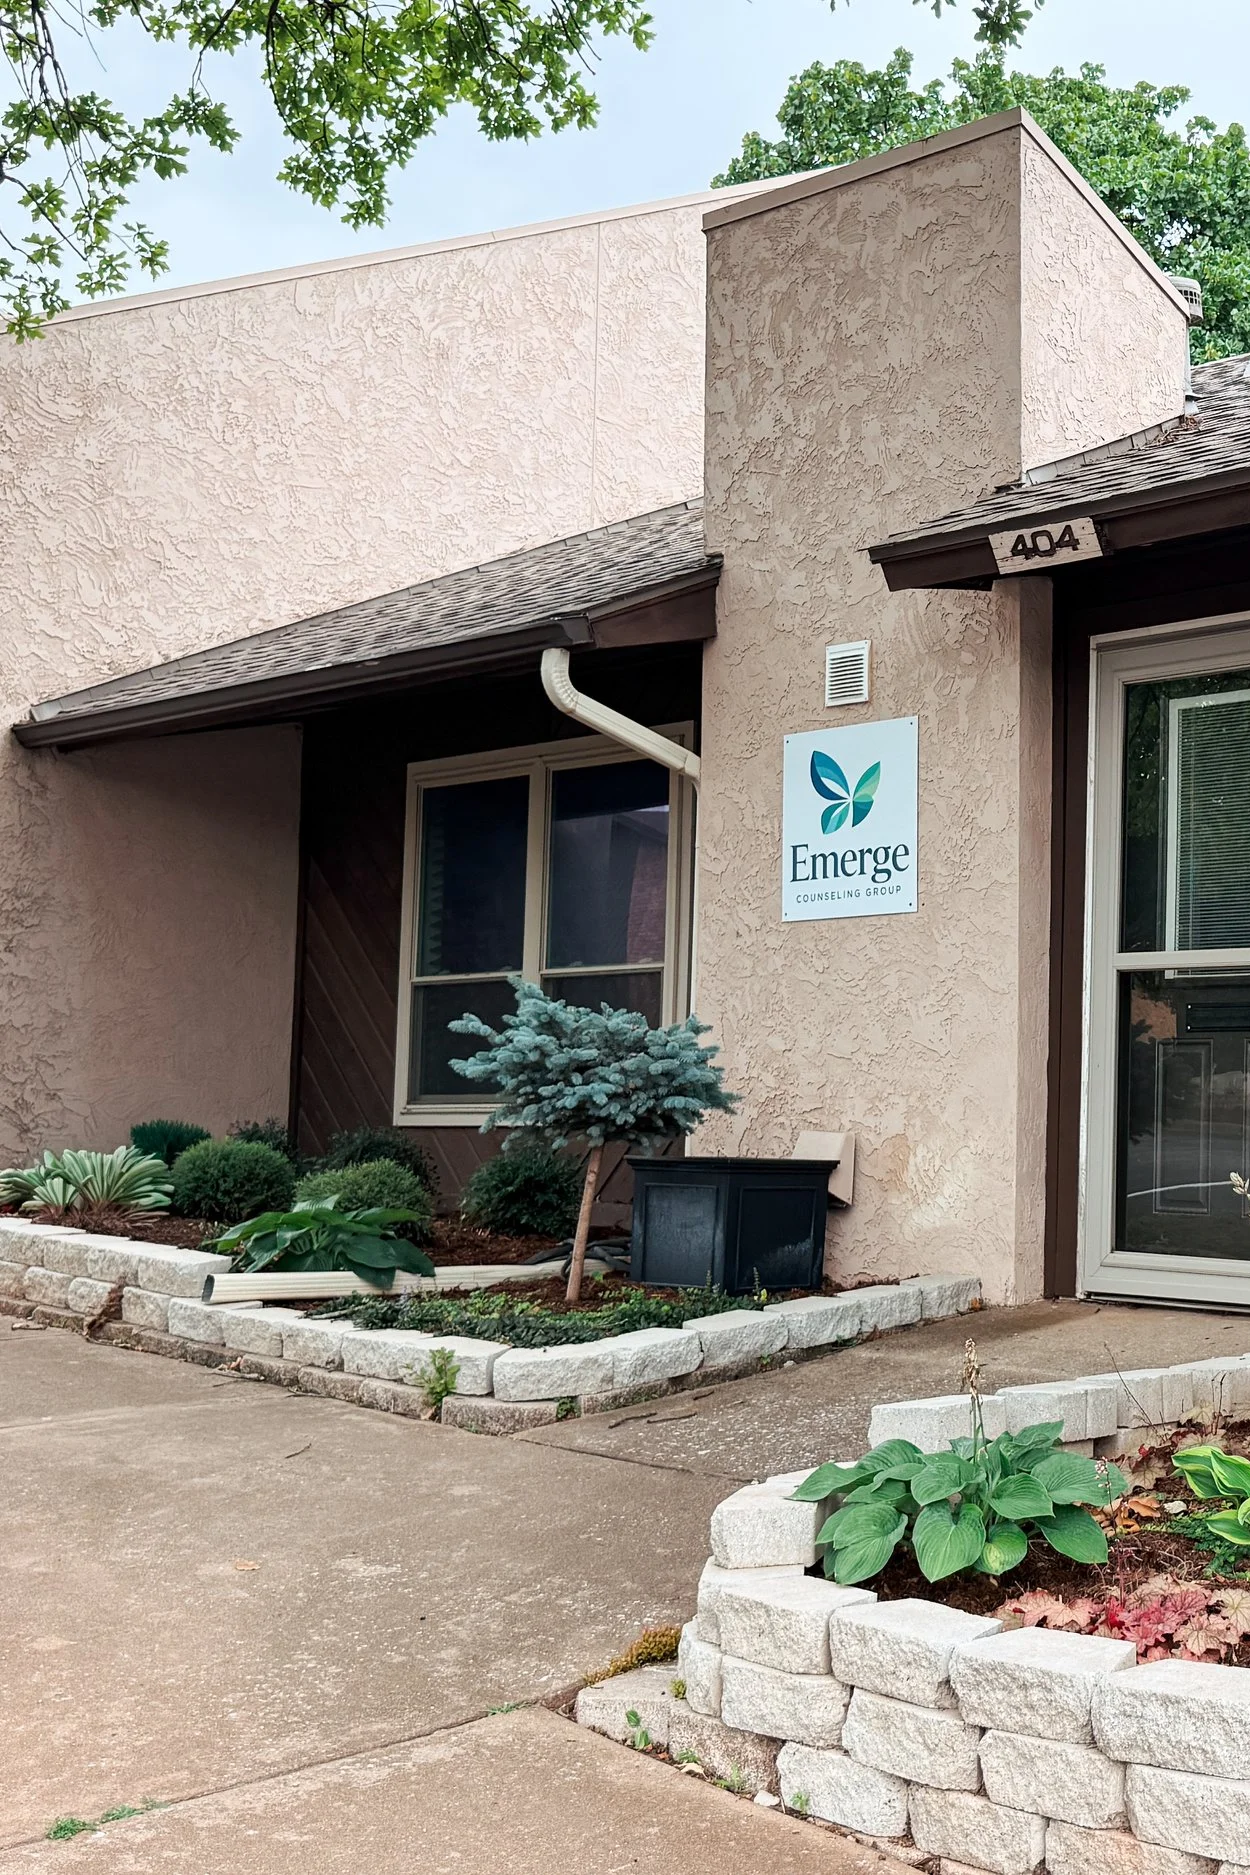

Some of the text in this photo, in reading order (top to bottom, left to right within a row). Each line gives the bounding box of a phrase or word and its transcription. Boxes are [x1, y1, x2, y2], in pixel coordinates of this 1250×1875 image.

[1011, 525, 1080, 560] 404
[790, 844, 909, 883] Emerge
[796, 885, 901, 903] COUNSELING GROUP
